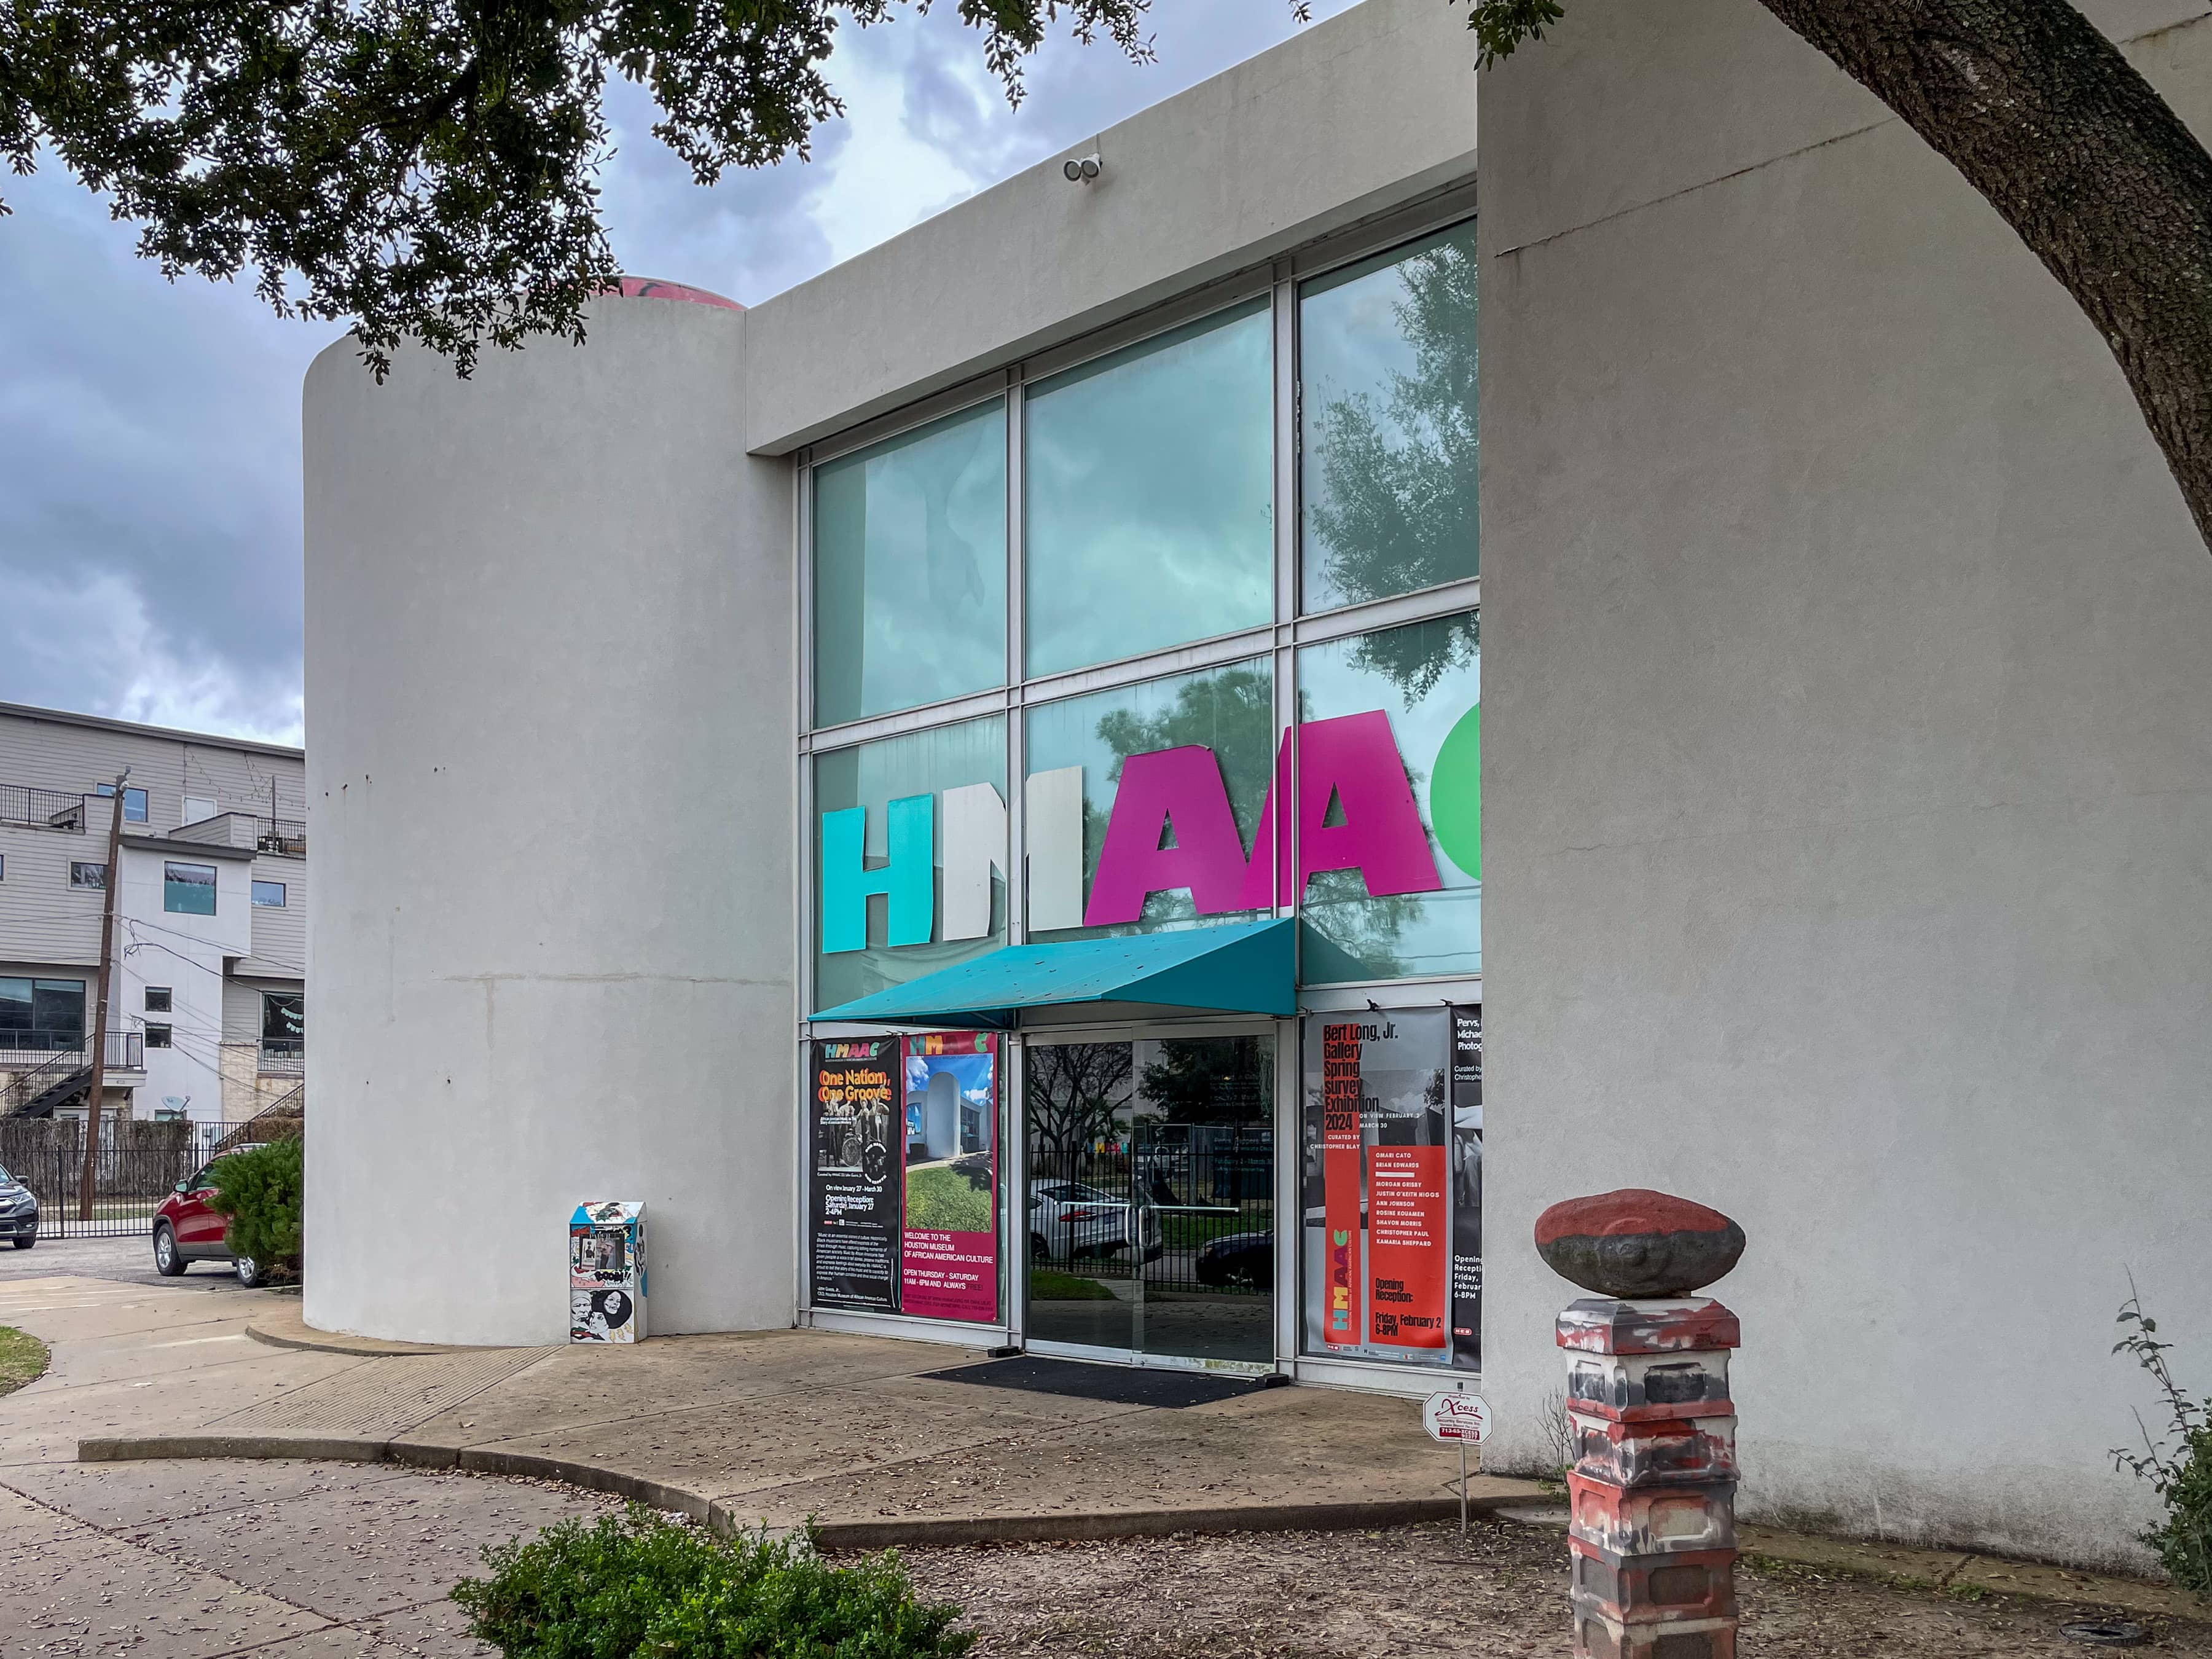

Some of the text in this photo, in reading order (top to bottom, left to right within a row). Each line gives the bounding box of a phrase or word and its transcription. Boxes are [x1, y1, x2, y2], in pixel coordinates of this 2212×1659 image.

[1457, 1018, 1480, 1028] Pervs,
[1324, 1022, 1398, 1041] Bert Long, Jr.
[825, 1042, 880, 1058] HMAAC
[1324, 1041, 1363, 1061] Gallery
[1457, 1041, 1483, 1052] Photog
[819, 1068, 890, 1086] One Nation,
[1324, 1059, 1360, 1079] Spring
[818, 1086, 892, 1102] One Groove
[1325, 1080, 1363, 1096] survey
[1325, 1094, 1379, 1112] Exhibition
[1325, 1113, 1353, 1131] 2024
[825, 1194, 847, 1203] Opening
[904, 1232, 930, 1241] WELCOME
[935, 1253, 965, 1261] AMERICAN
[966, 1255, 994, 1263] CULTURE
[918, 1270, 945, 1279] THURSDAY
[949, 1273, 979, 1281] SATURDAY
[1333, 1229, 1348, 1330] HMAAC
[1454, 1273, 1479, 1282] Friday,
[1376, 1277, 1404, 1292] Opening
[1375, 1289, 1413, 1303] Reception:
[1375, 1312, 1441, 1329] Friday, February 2
[1376, 1324, 1398, 1336] 6-8PM
[1435, 1398, 1481, 1418] Xcess
